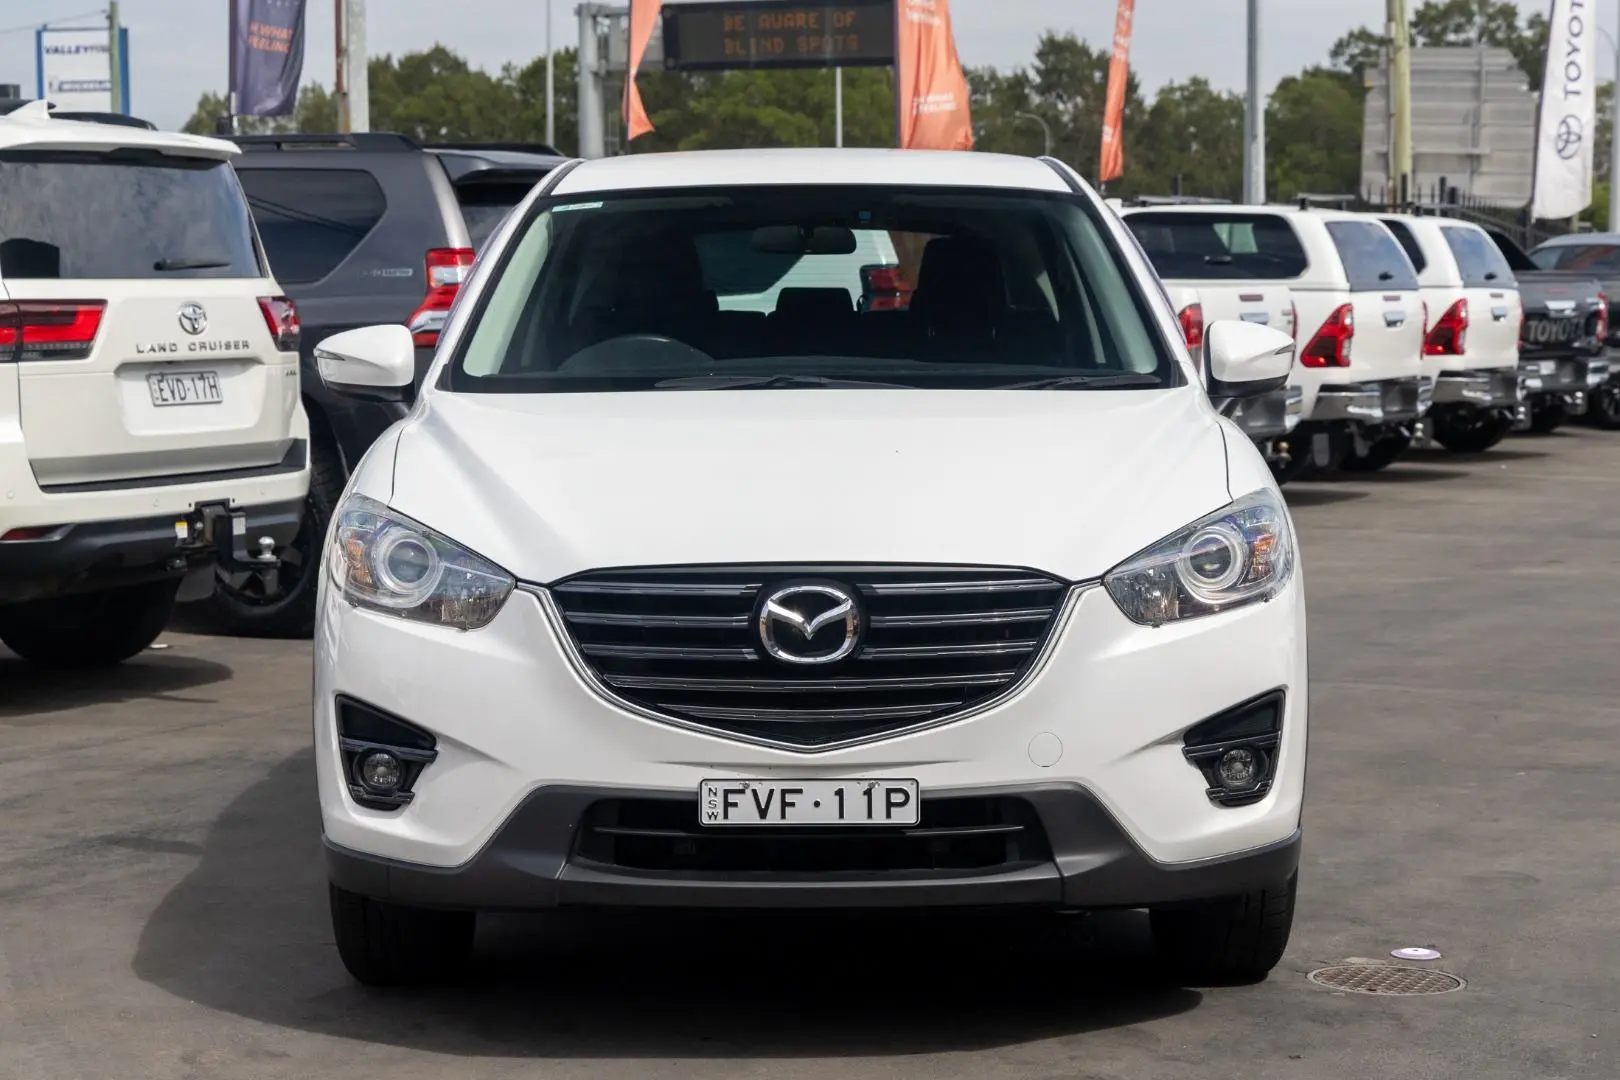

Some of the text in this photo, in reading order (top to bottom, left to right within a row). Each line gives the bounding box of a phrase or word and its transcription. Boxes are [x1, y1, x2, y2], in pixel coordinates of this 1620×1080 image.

[723, 10, 856, 32] BE AWARE OF
[723, 34, 858, 55] BLIND SPOTS
[136, 340, 250, 354] LAND CRUISER
